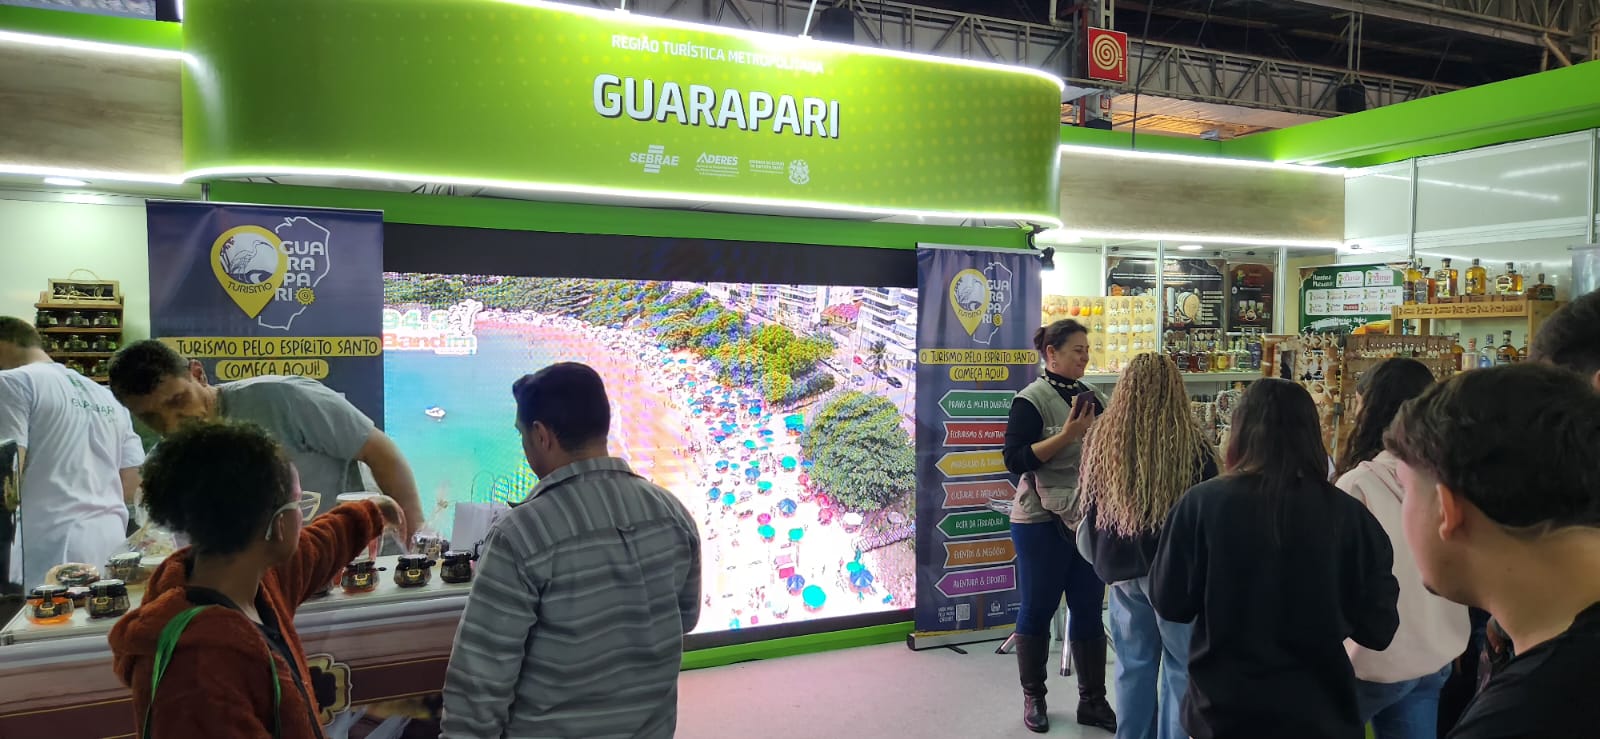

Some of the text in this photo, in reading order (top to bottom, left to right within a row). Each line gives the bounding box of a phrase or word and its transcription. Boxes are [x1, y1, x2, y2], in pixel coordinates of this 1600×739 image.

[611, 34, 659, 53] REGIÃO
[663, 41, 725, 61] TURÍSTICA
[593, 73, 840, 139] GUARAPARI
[629, 152, 680, 166] SEBRAE
[696, 152, 738, 166] ADERES
[279, 240, 325, 256] GUA
[287, 257, 315, 271] RA
[283, 272, 311, 287] PA
[985, 279, 1009, 290] GUA
[228, 281, 273, 294] TURISMO
[274, 287, 293, 301] RI
[988, 291, 1004, 302] RA
[987, 302, 1002, 313] PA
[176, 337, 378, 356] TURISMO PELO ESPÍRITO SANTO
[921, 350, 1036, 363] O TURISMO PELO ESPÍRITO SANTO
[954, 368, 983, 380] COMEÇA
[966, 400, 972, 409] &
[952, 578, 979, 589] AVENTURA
[980, 576, 985, 586] &
